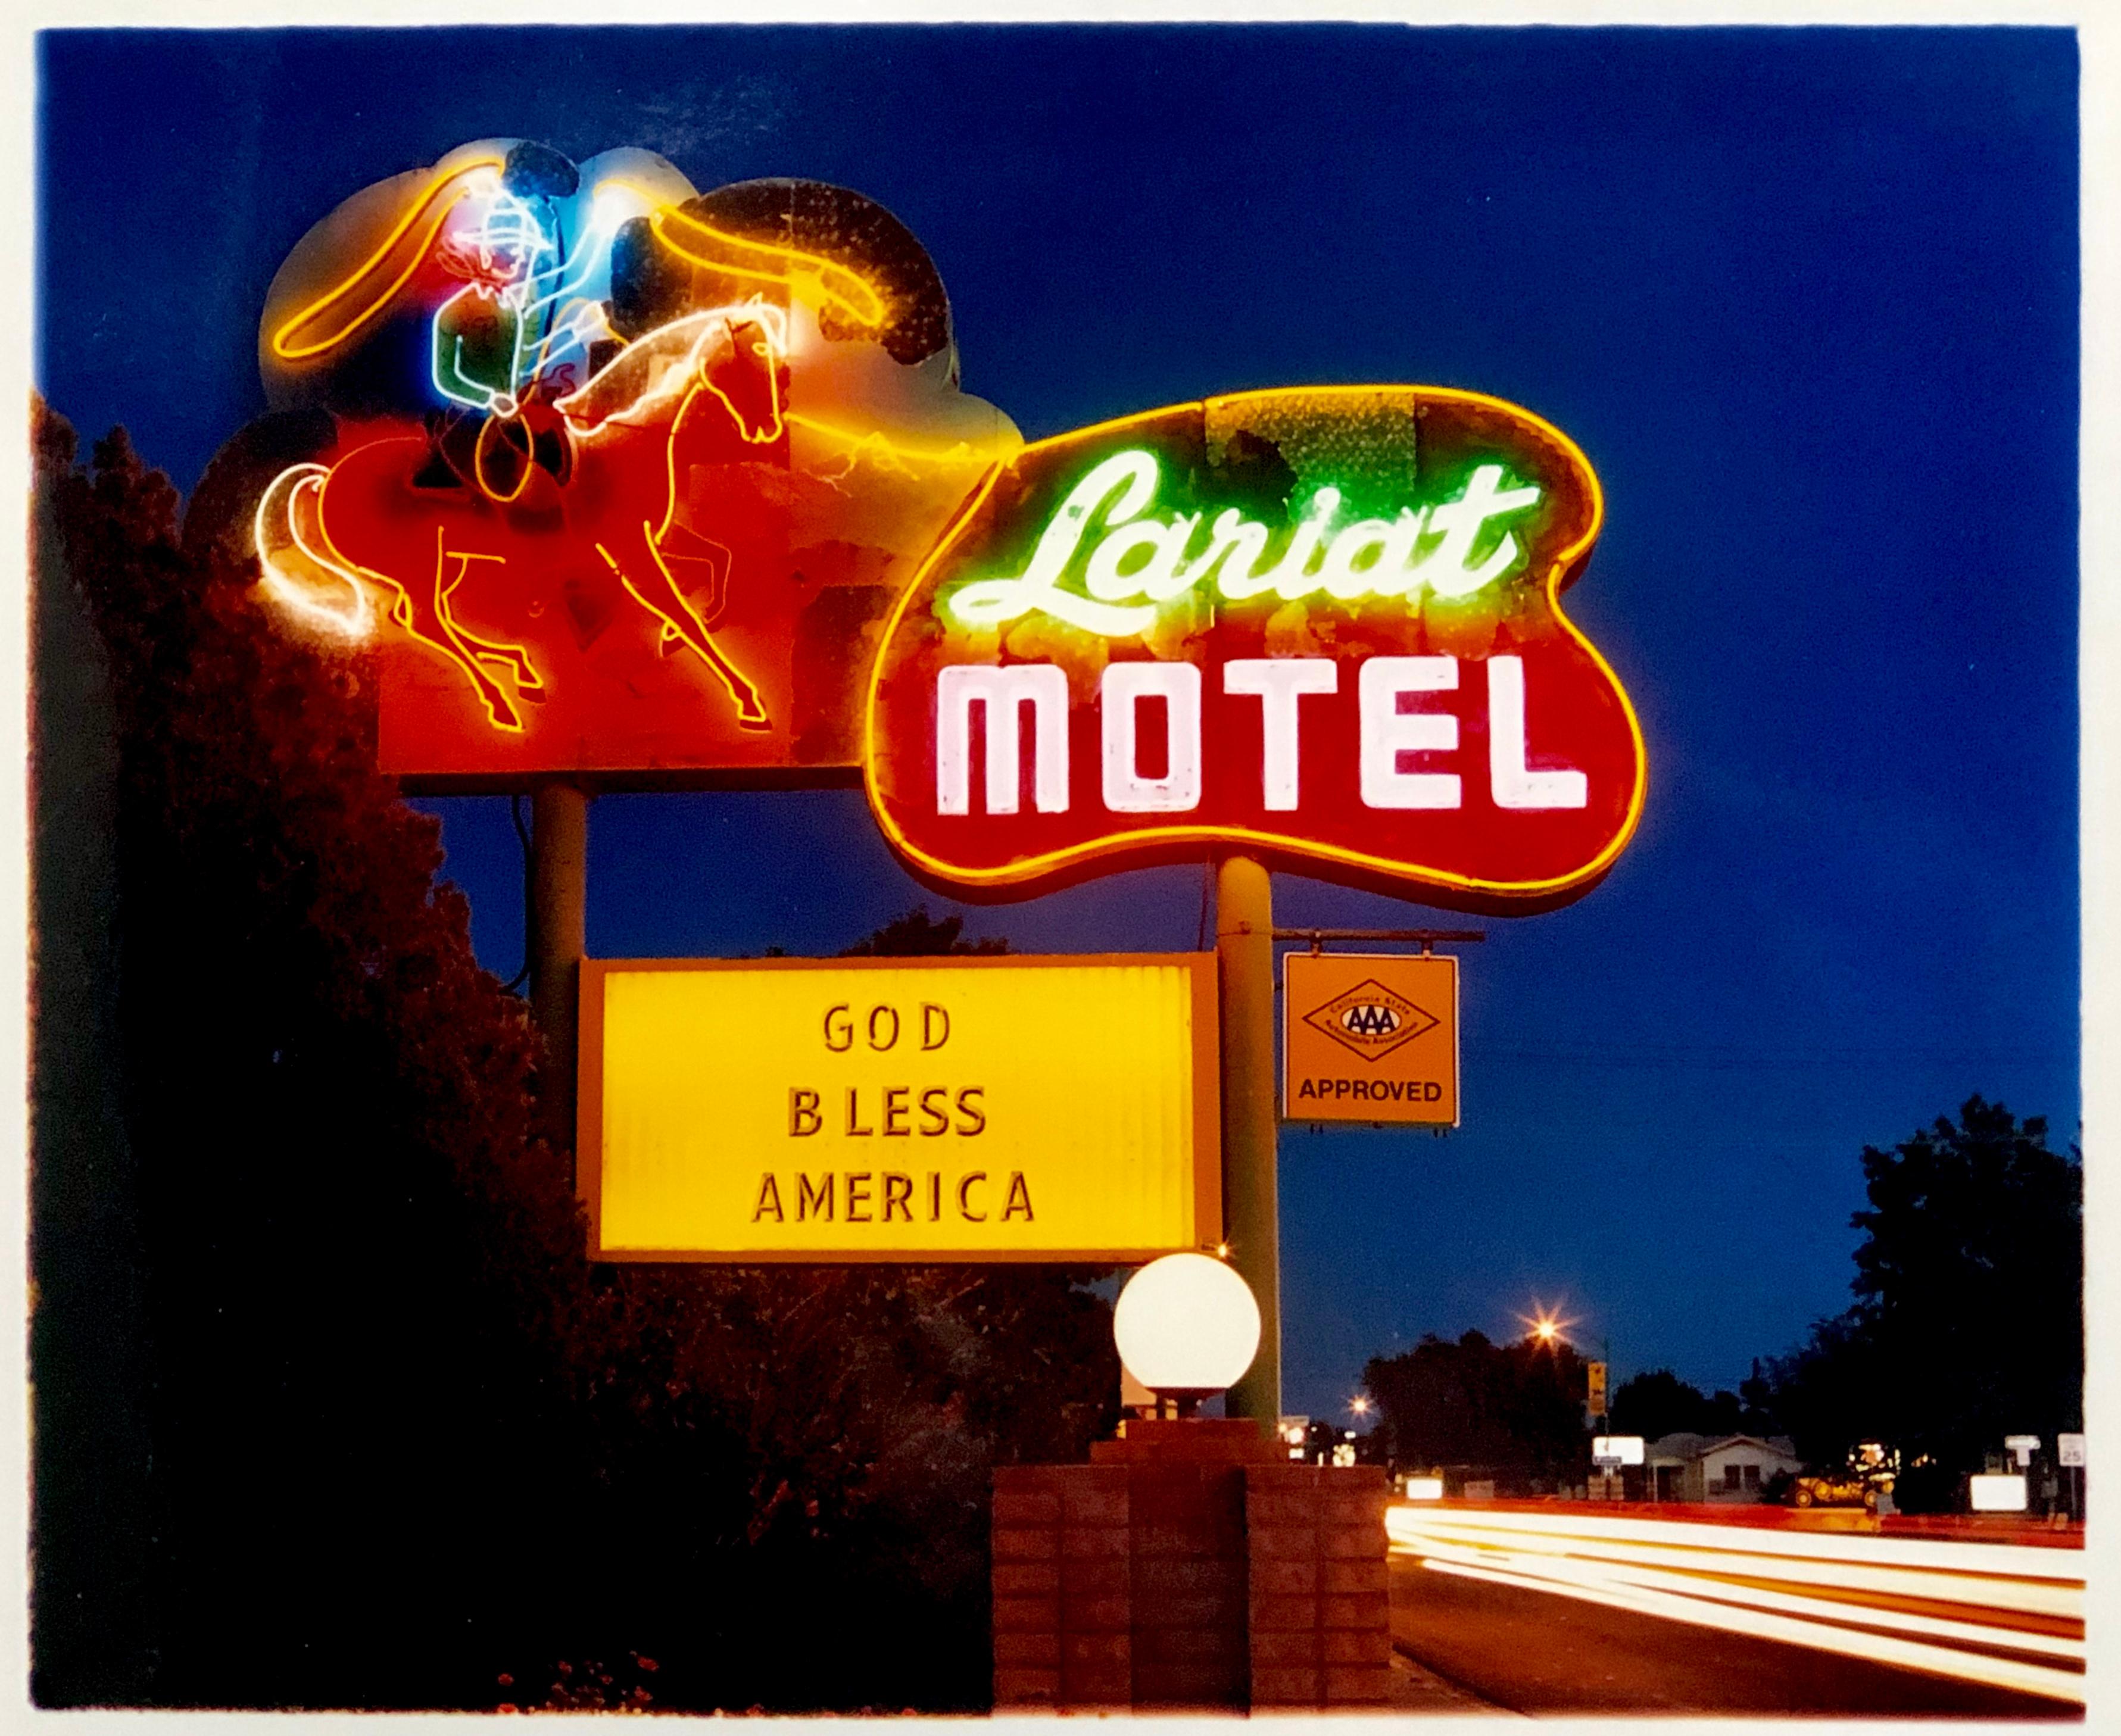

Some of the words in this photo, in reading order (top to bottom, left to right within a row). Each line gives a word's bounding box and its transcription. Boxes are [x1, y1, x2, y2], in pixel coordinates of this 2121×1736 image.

[947, 449, 1540, 636] Lariat
[937, 655, 1587, 815] MOTEL
[824, 1001, 950, 1052] GOD
[1347, 1004, 1397, 1035] AAA
[788, 1085, 986, 1136] BLESS
[1299, 1079, 1442, 1101] APPROVED
[751, 1171, 1034, 1222] AMERICA
[2063, 1450, 2081, 1462] 25
